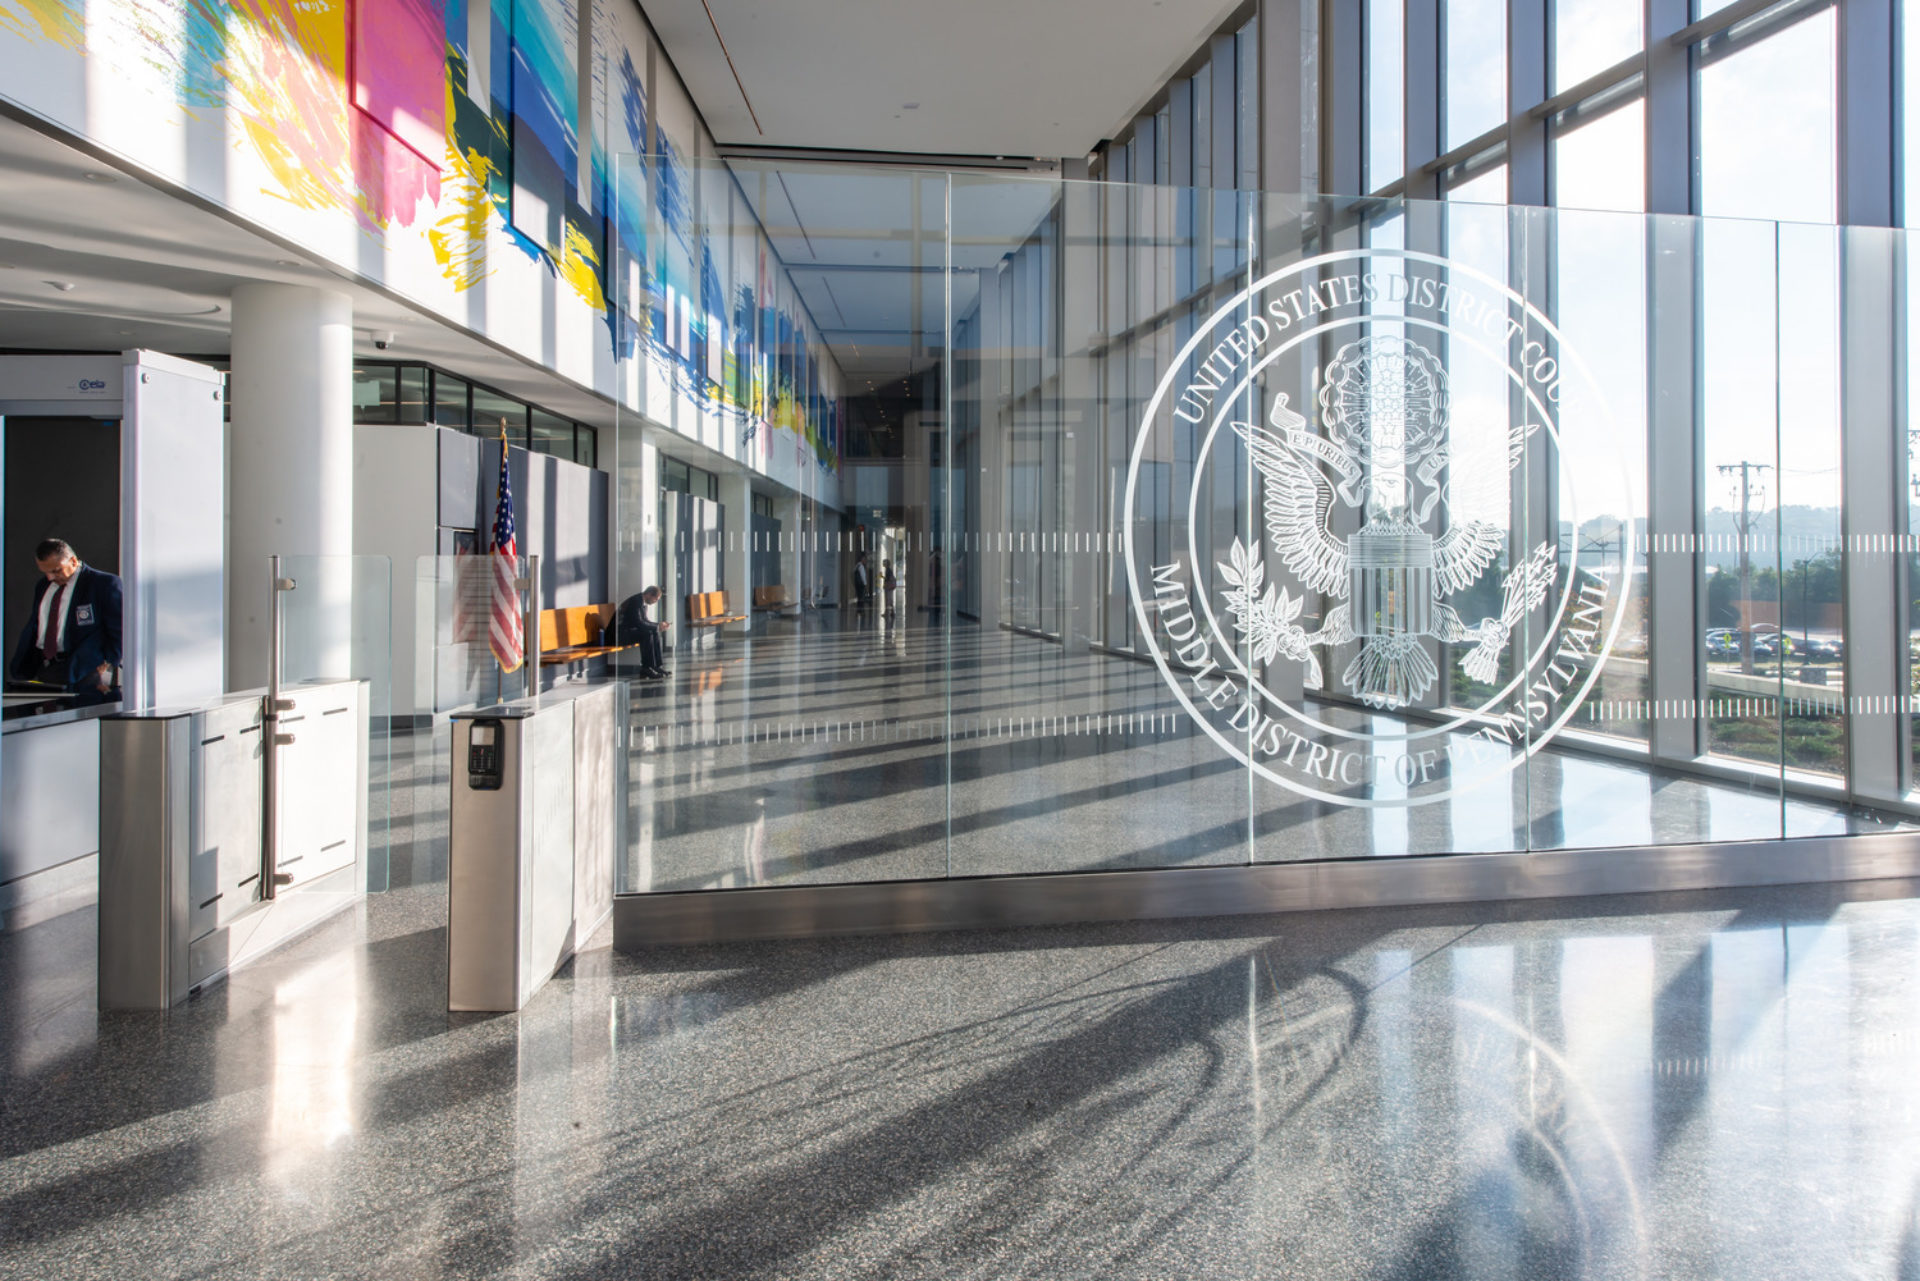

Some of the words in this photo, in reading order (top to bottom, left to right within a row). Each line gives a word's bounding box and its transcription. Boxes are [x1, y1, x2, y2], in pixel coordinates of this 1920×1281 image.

[1173, 315, 1270, 424] UNITED
[1268, 273, 1378, 331] STATES
[1387, 273, 1524, 346] DISTRICT
[1150, 560, 1239, 711] MIDDLE
[1226, 697, 1386, 787] DISTRICT
[1394, 750, 1438, 786] OF
[1444, 564, 1613, 775] PENNSYLVANIA
